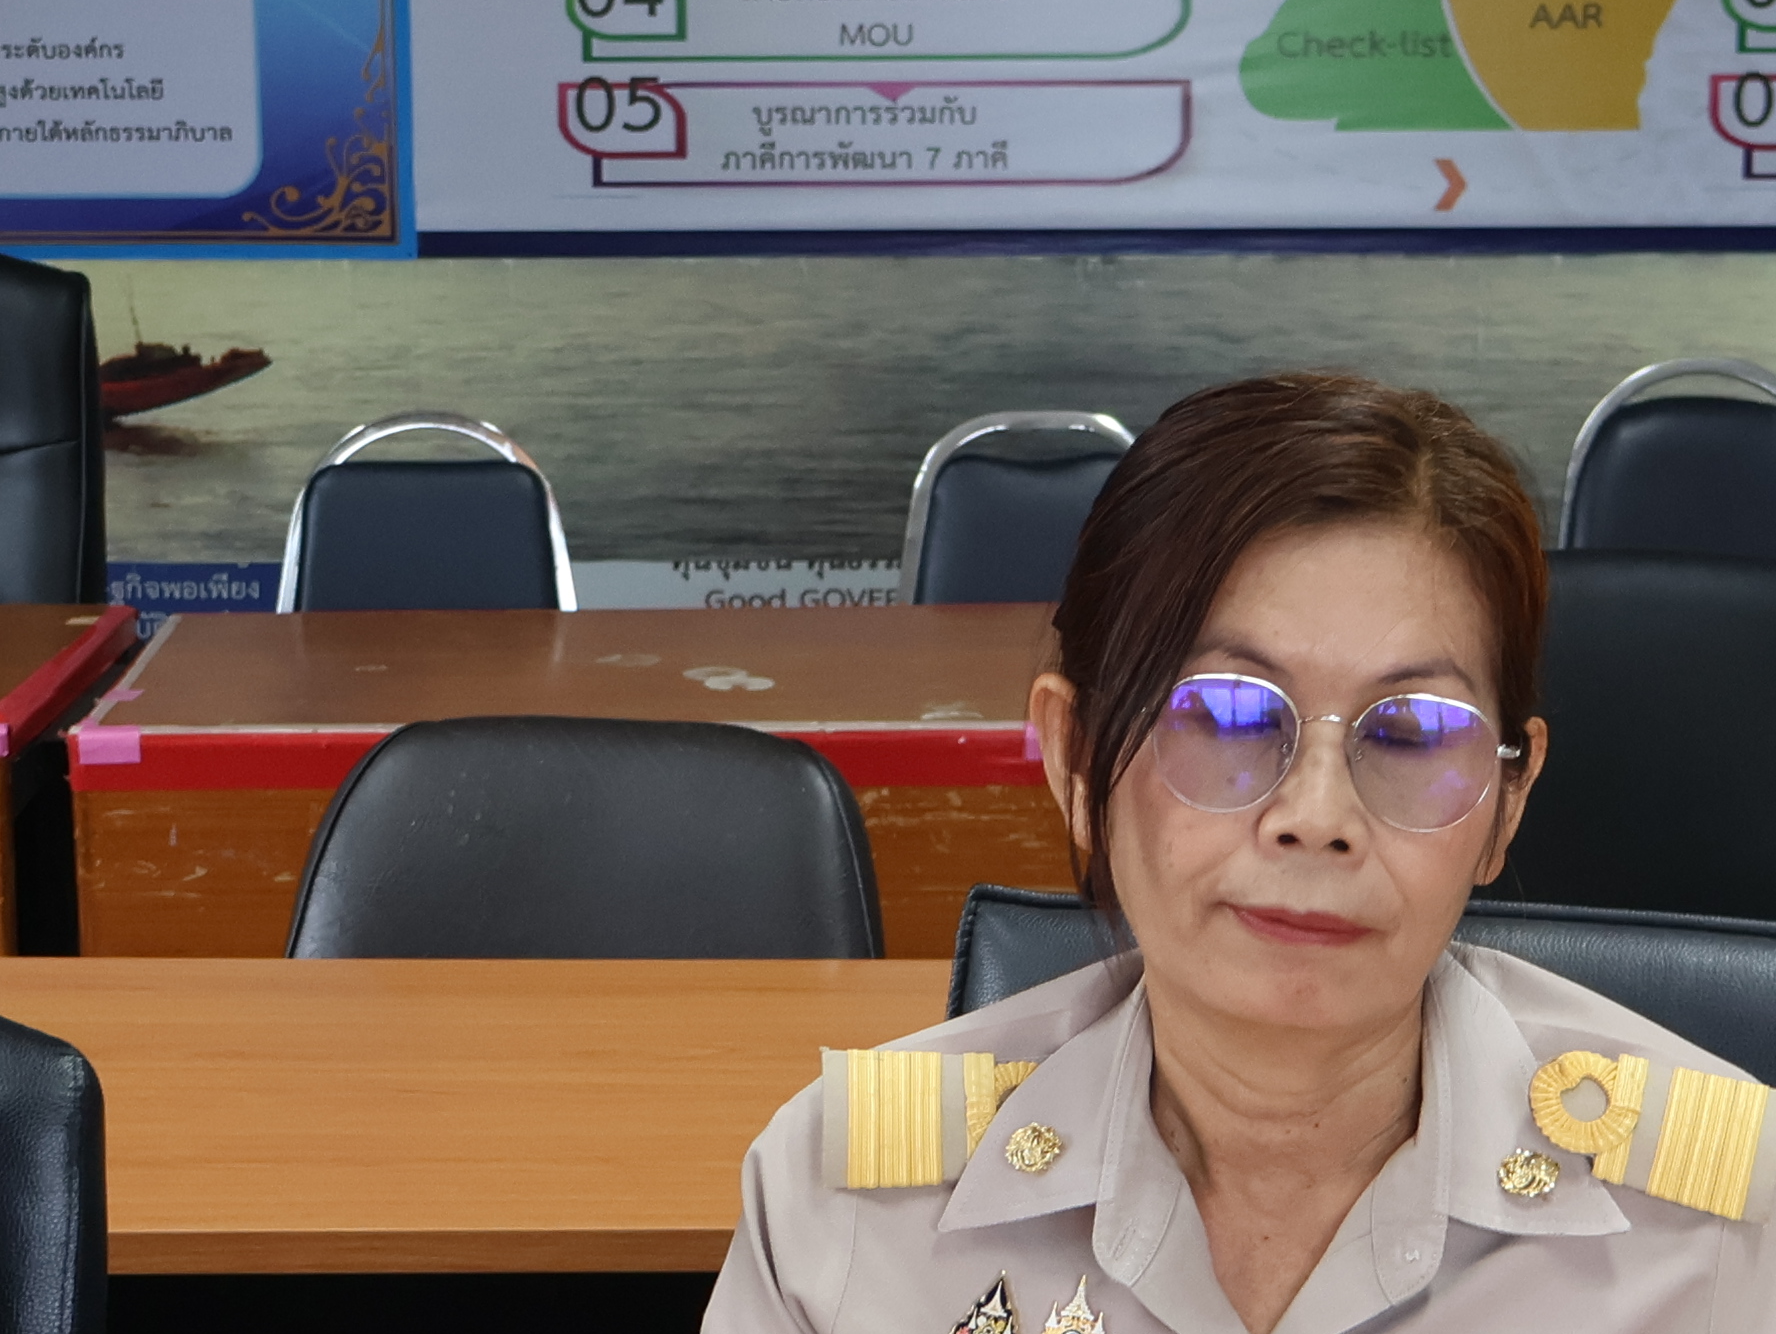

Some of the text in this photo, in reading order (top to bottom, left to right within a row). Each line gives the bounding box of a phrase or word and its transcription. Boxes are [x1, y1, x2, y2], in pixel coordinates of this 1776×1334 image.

[1529, 4, 1601, 29] AAR
[839, 22, 914, 46] MOU
[1276, 29, 1453, 60] Check-list
[575, 76, 662, 133] 05
[927, 147, 941, 169] 7
[705, 590, 785, 609] Good
